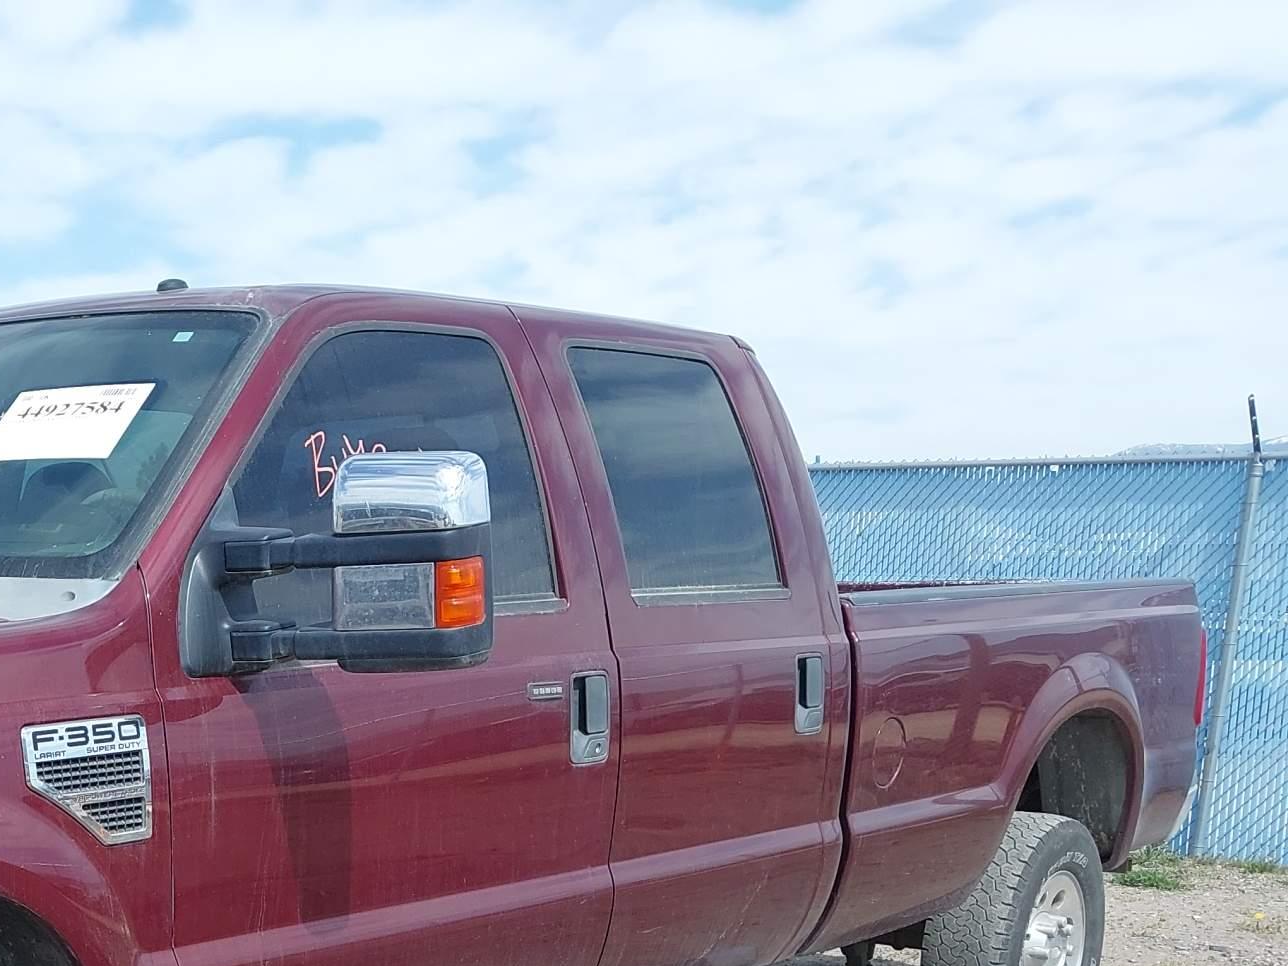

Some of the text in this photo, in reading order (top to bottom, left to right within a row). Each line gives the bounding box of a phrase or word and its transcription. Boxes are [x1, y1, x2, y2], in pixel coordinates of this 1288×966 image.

[17, 400, 126, 419] 44927584
[86, 741, 142, 754] SUPER DUTY
[34, 750, 67, 760] LARIAT
